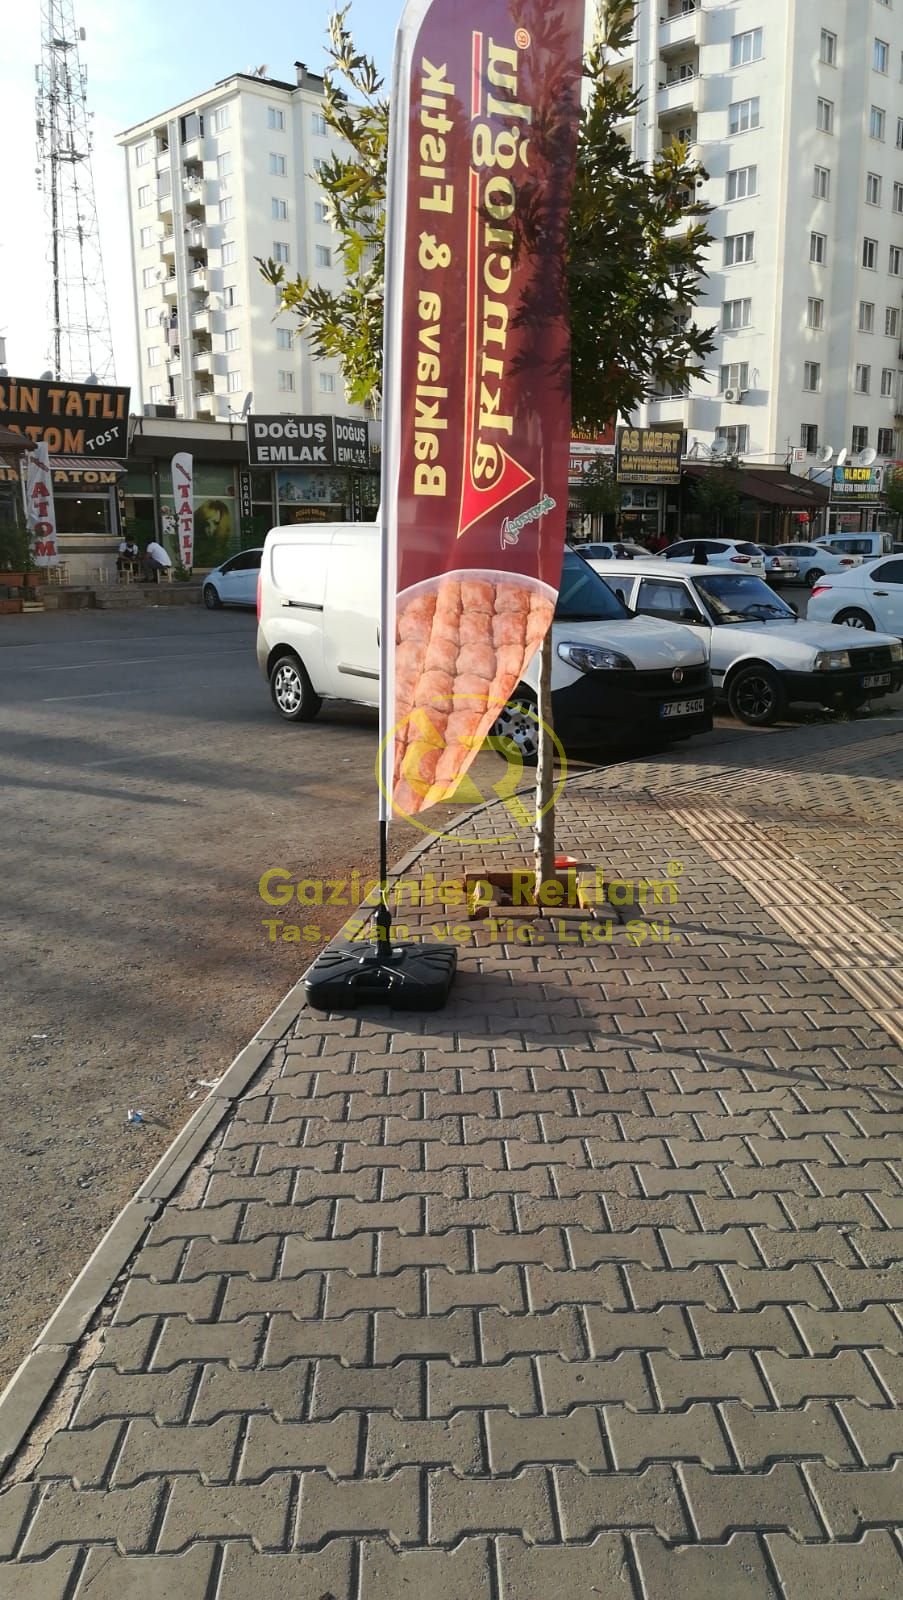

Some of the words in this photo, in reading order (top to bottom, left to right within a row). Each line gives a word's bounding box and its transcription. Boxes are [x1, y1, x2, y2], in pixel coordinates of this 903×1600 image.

[48, 389, 125, 419] TATLI
[86, 426, 120, 451] TOST
[254, 418, 327, 443] DOĞUŞ
[336, 422, 366, 446] DOĞUŞ
[621, 430, 640, 452] AS
[643, 431, 681, 453] MERT
[257, 446, 328, 461] EMLAK
[54, 470, 118, 483] ATOM
[31, 482, 57, 556] ATOM
[178, 484, 193, 565] TATLI
[664, 704, 672, 715] 27
